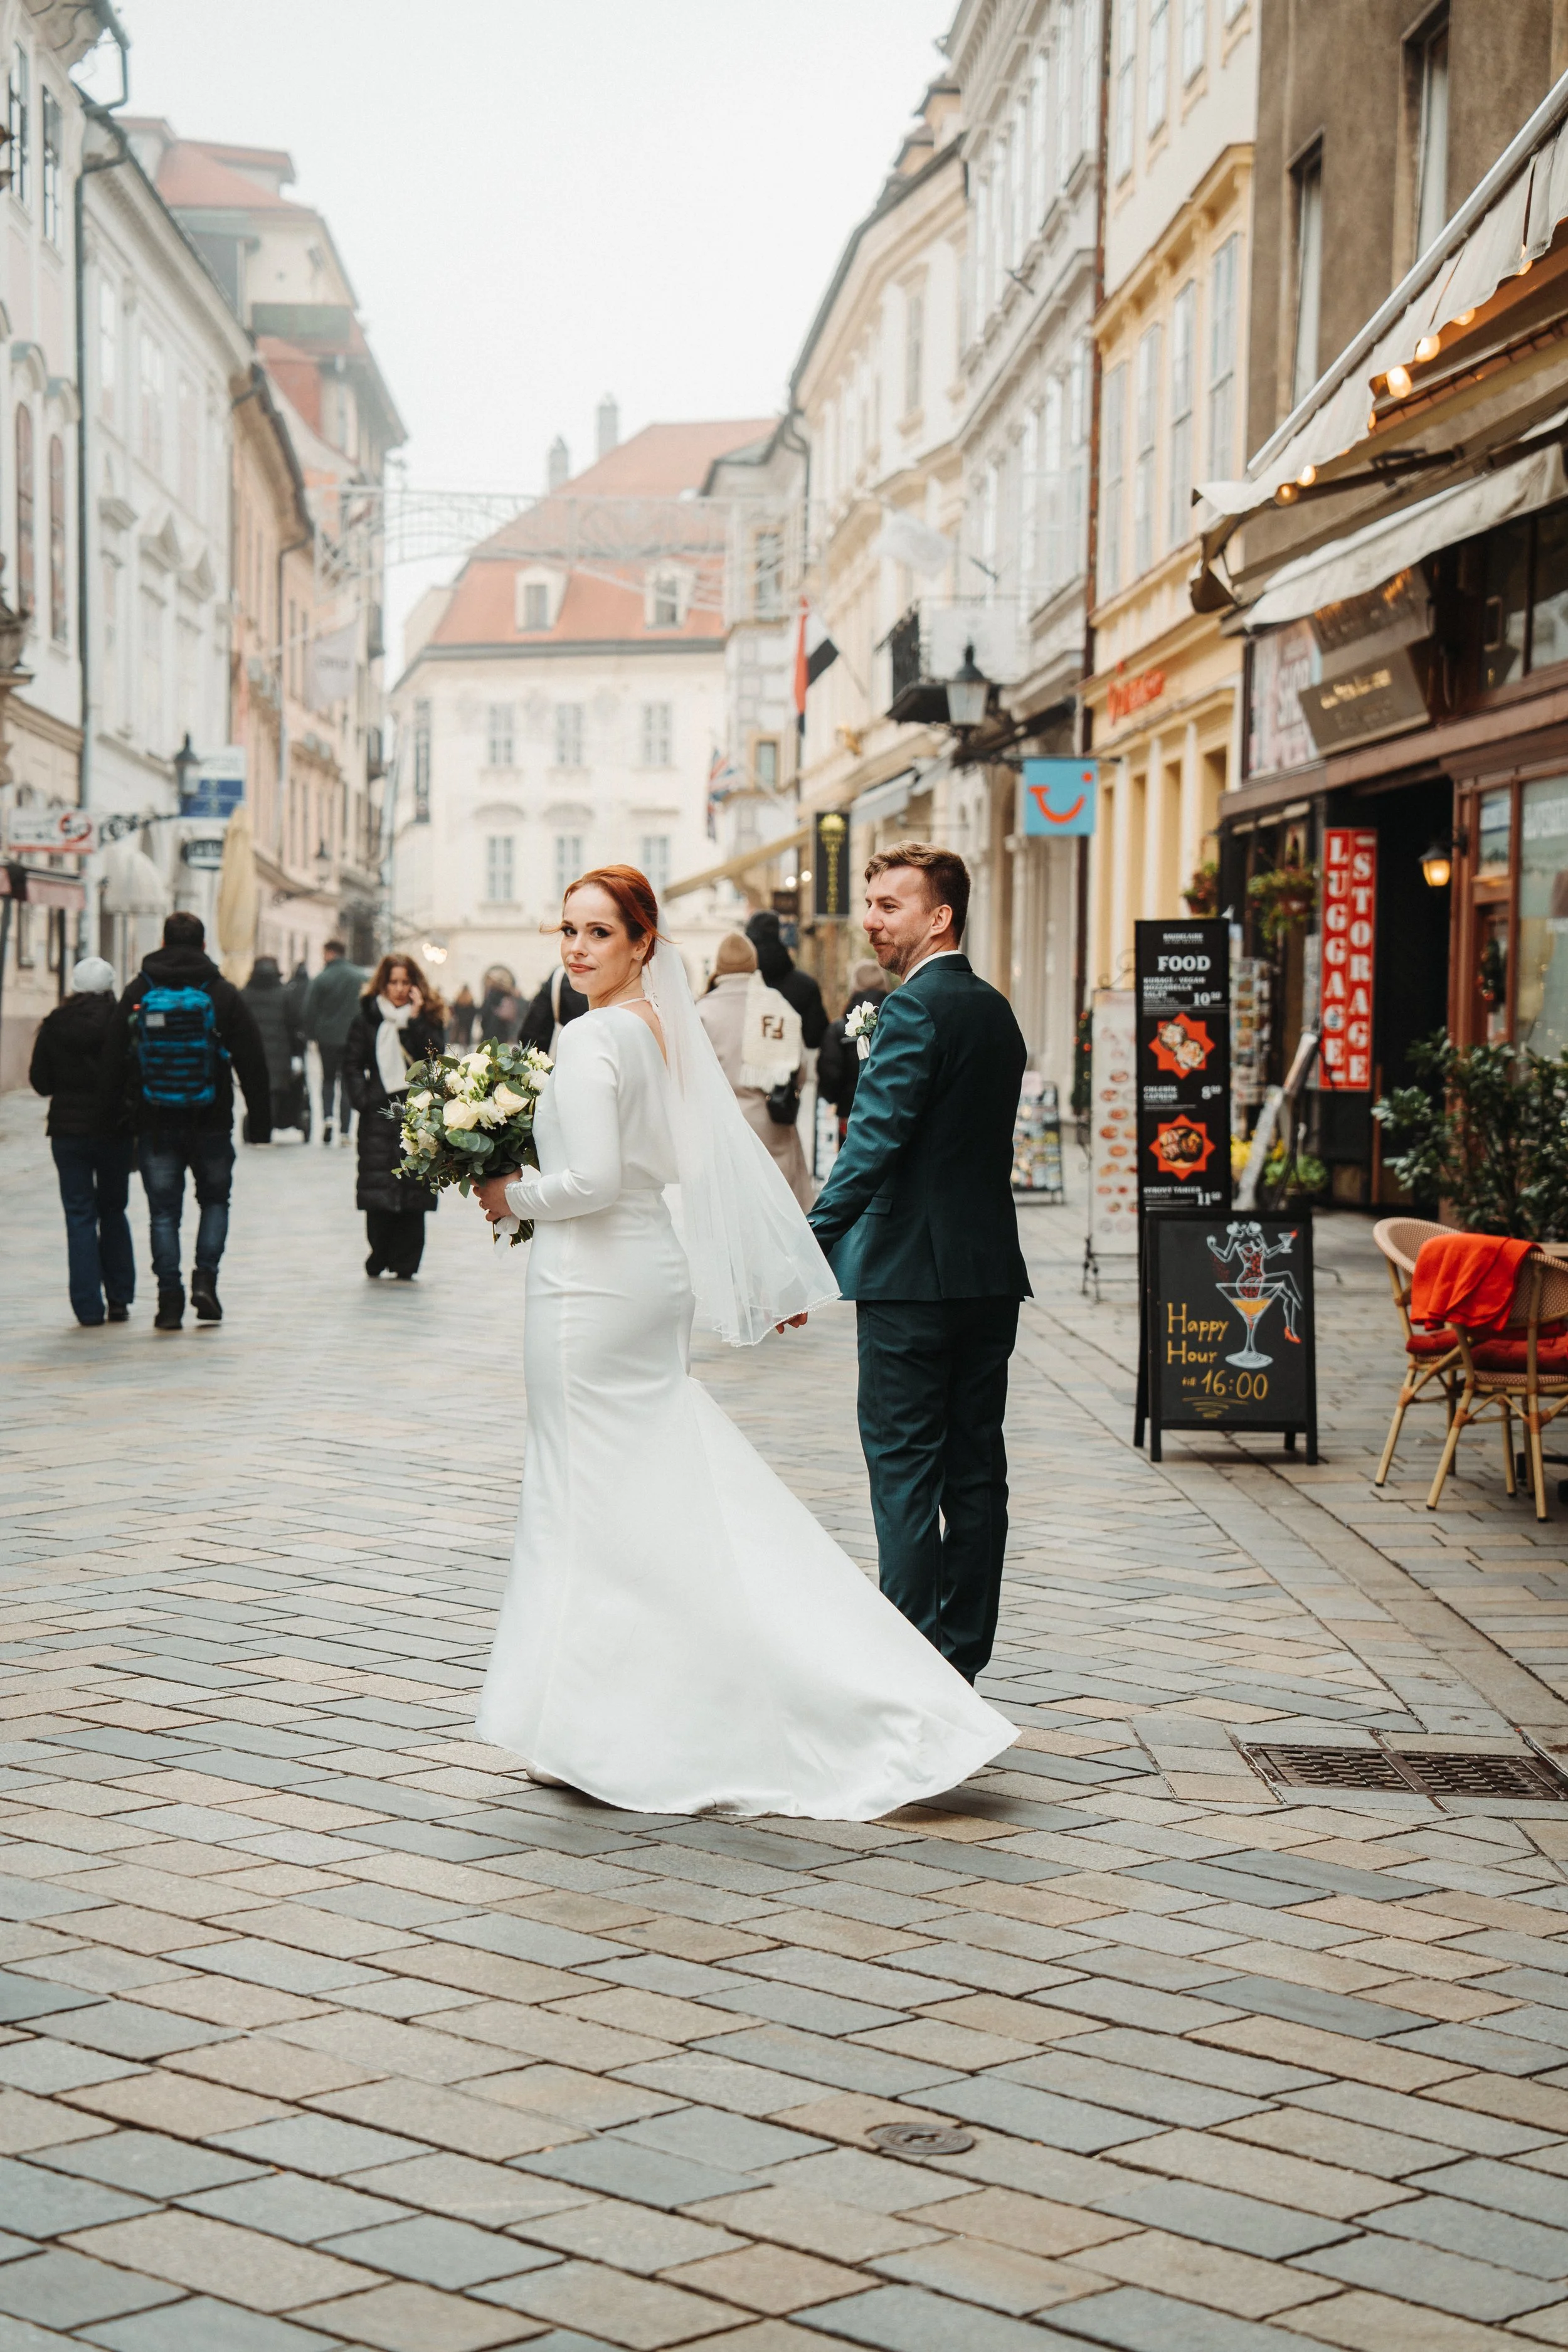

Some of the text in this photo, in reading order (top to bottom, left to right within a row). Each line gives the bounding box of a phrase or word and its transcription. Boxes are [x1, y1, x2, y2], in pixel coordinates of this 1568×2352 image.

[1157, 955, 1212, 972] FOOD
[1323, 836, 1348, 1067] LUGGAGE
[1347, 852, 1373, 1083] STORAGE
[1167, 1302, 1229, 1342] Happy
[1167, 1340, 1219, 1365] Hour
[1200, 1369, 1269, 1401] 16:00
